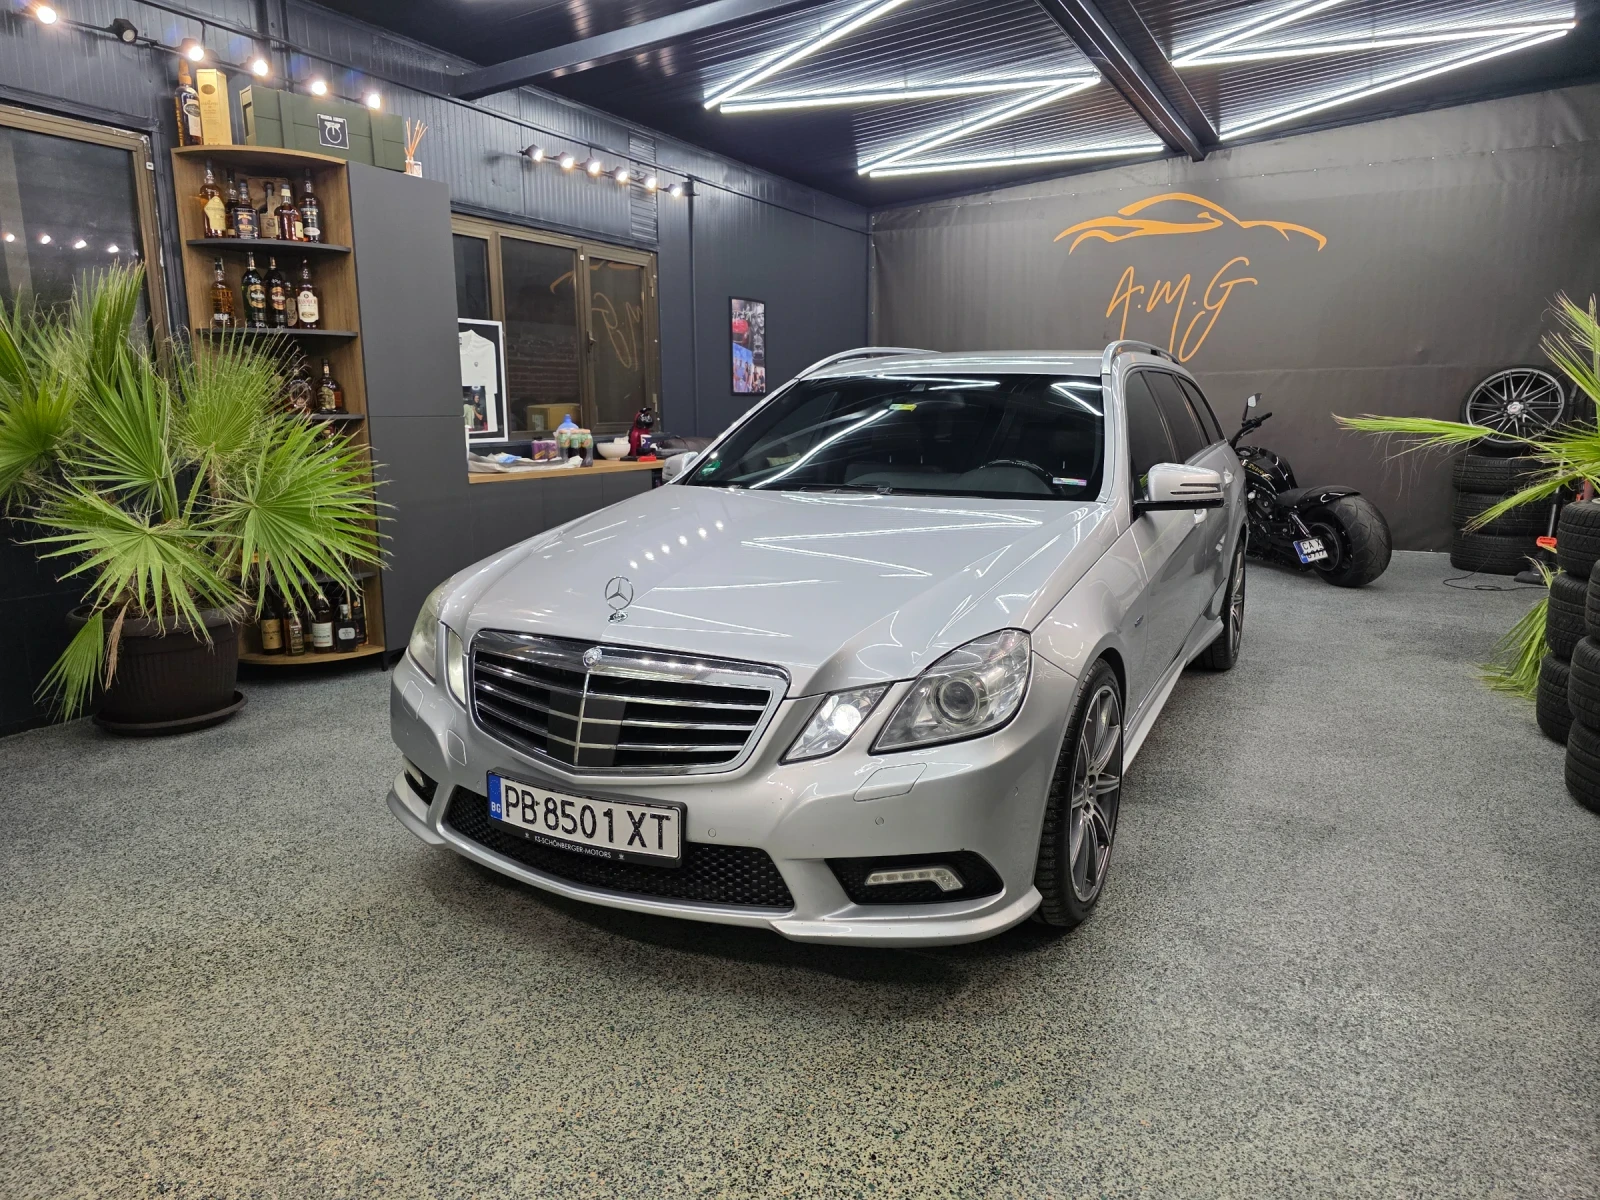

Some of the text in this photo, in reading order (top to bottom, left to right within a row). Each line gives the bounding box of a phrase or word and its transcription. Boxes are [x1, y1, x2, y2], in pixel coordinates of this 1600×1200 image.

[491, 801, 501, 813] BG
[504, 784, 671, 850] PB 8501 XT
